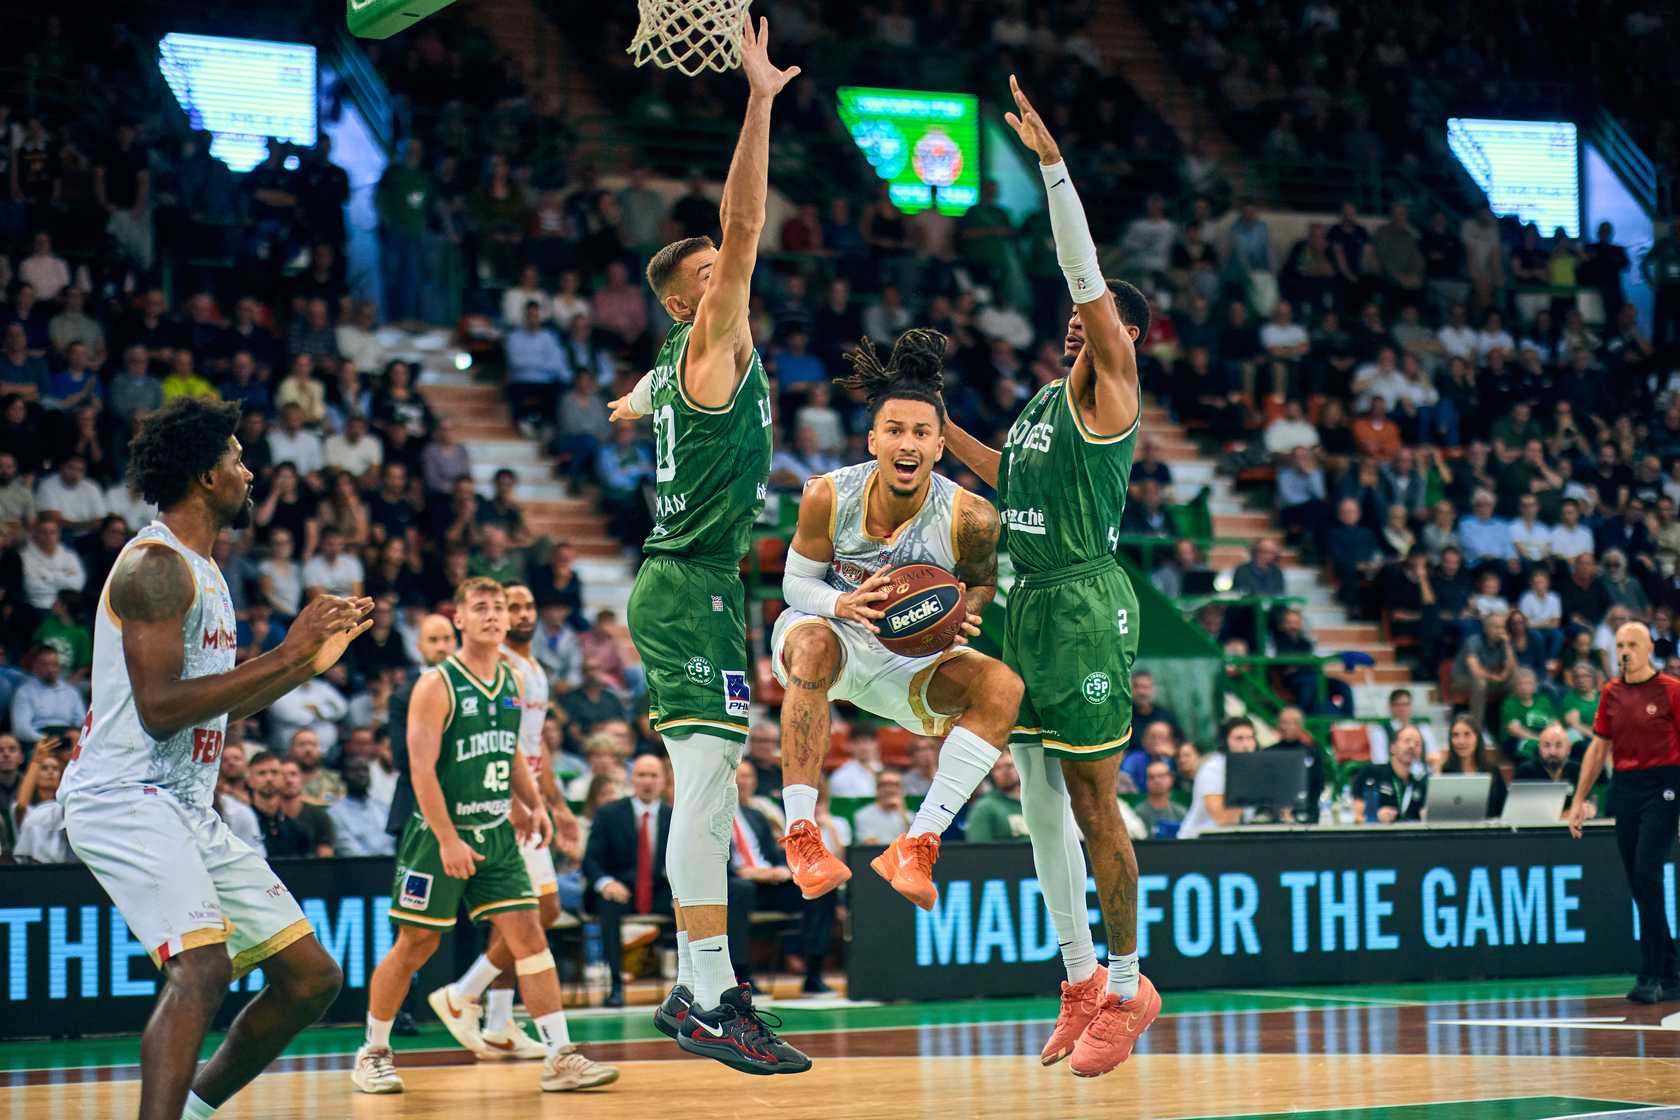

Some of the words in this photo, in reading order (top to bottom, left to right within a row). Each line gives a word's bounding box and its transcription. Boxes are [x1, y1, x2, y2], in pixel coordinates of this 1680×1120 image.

[890, 600, 940, 630] Betclic
[1117, 608, 1129, 634] 2
[687, 662, 711, 676] CSP
[1086, 678, 1108, 695] CSP
[1136, 872, 1262, 959] FOR
[1280, 868, 1400, 953] THE
[1421, 864, 1587, 949] GAME
[0, 905, 156, 1001] THE
